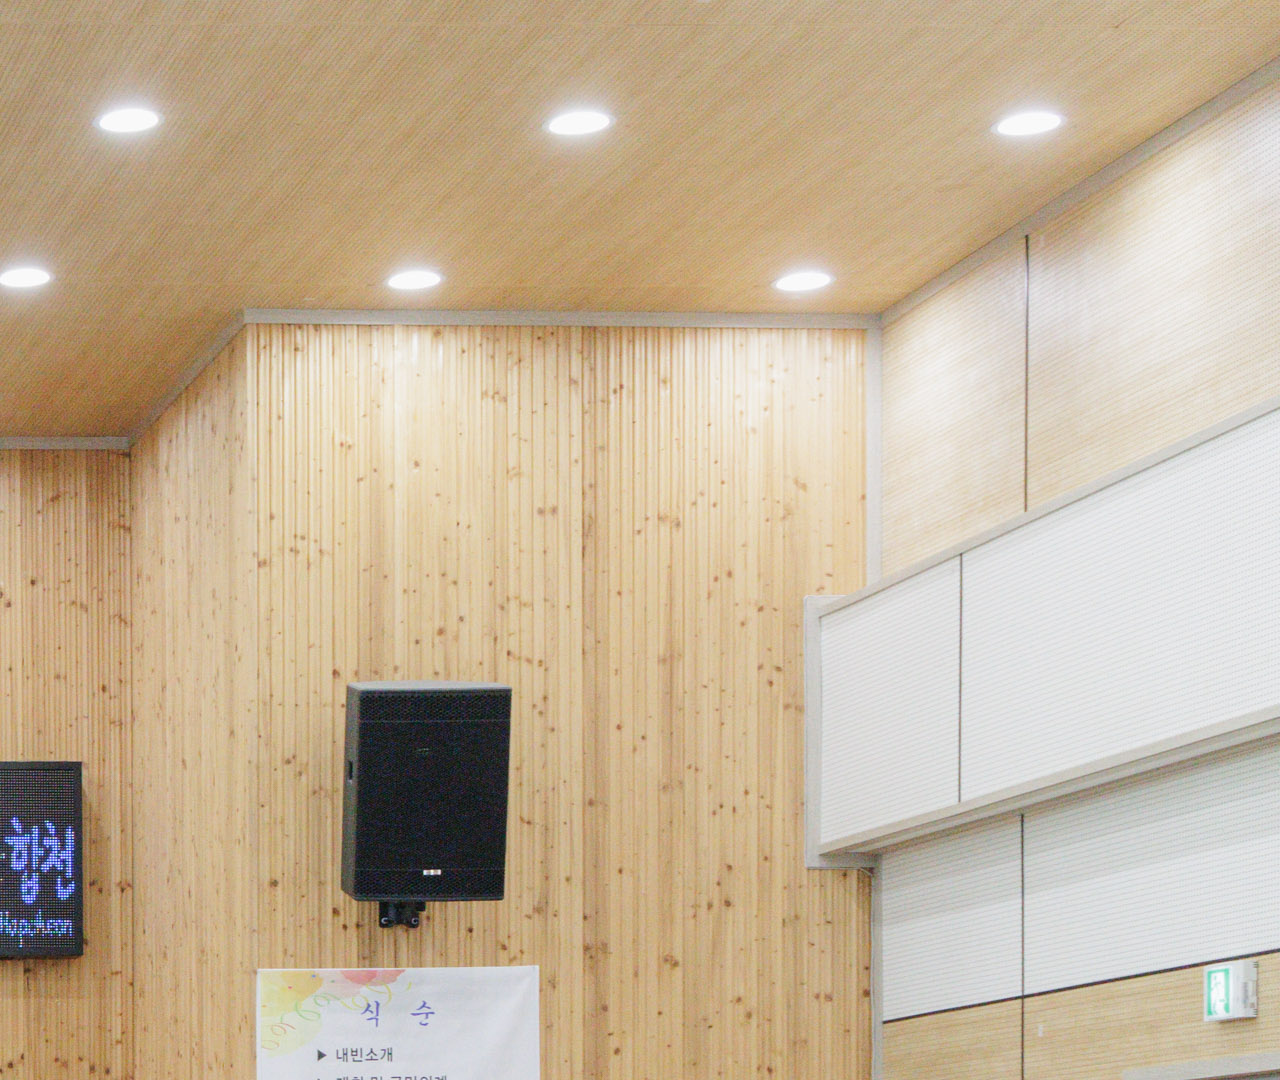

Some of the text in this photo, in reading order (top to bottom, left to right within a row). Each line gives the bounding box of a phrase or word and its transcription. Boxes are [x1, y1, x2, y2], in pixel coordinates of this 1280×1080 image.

[361, 1000, 435, 1028] 식 순
[336, 1047, 393, 1063] 내빈소개
